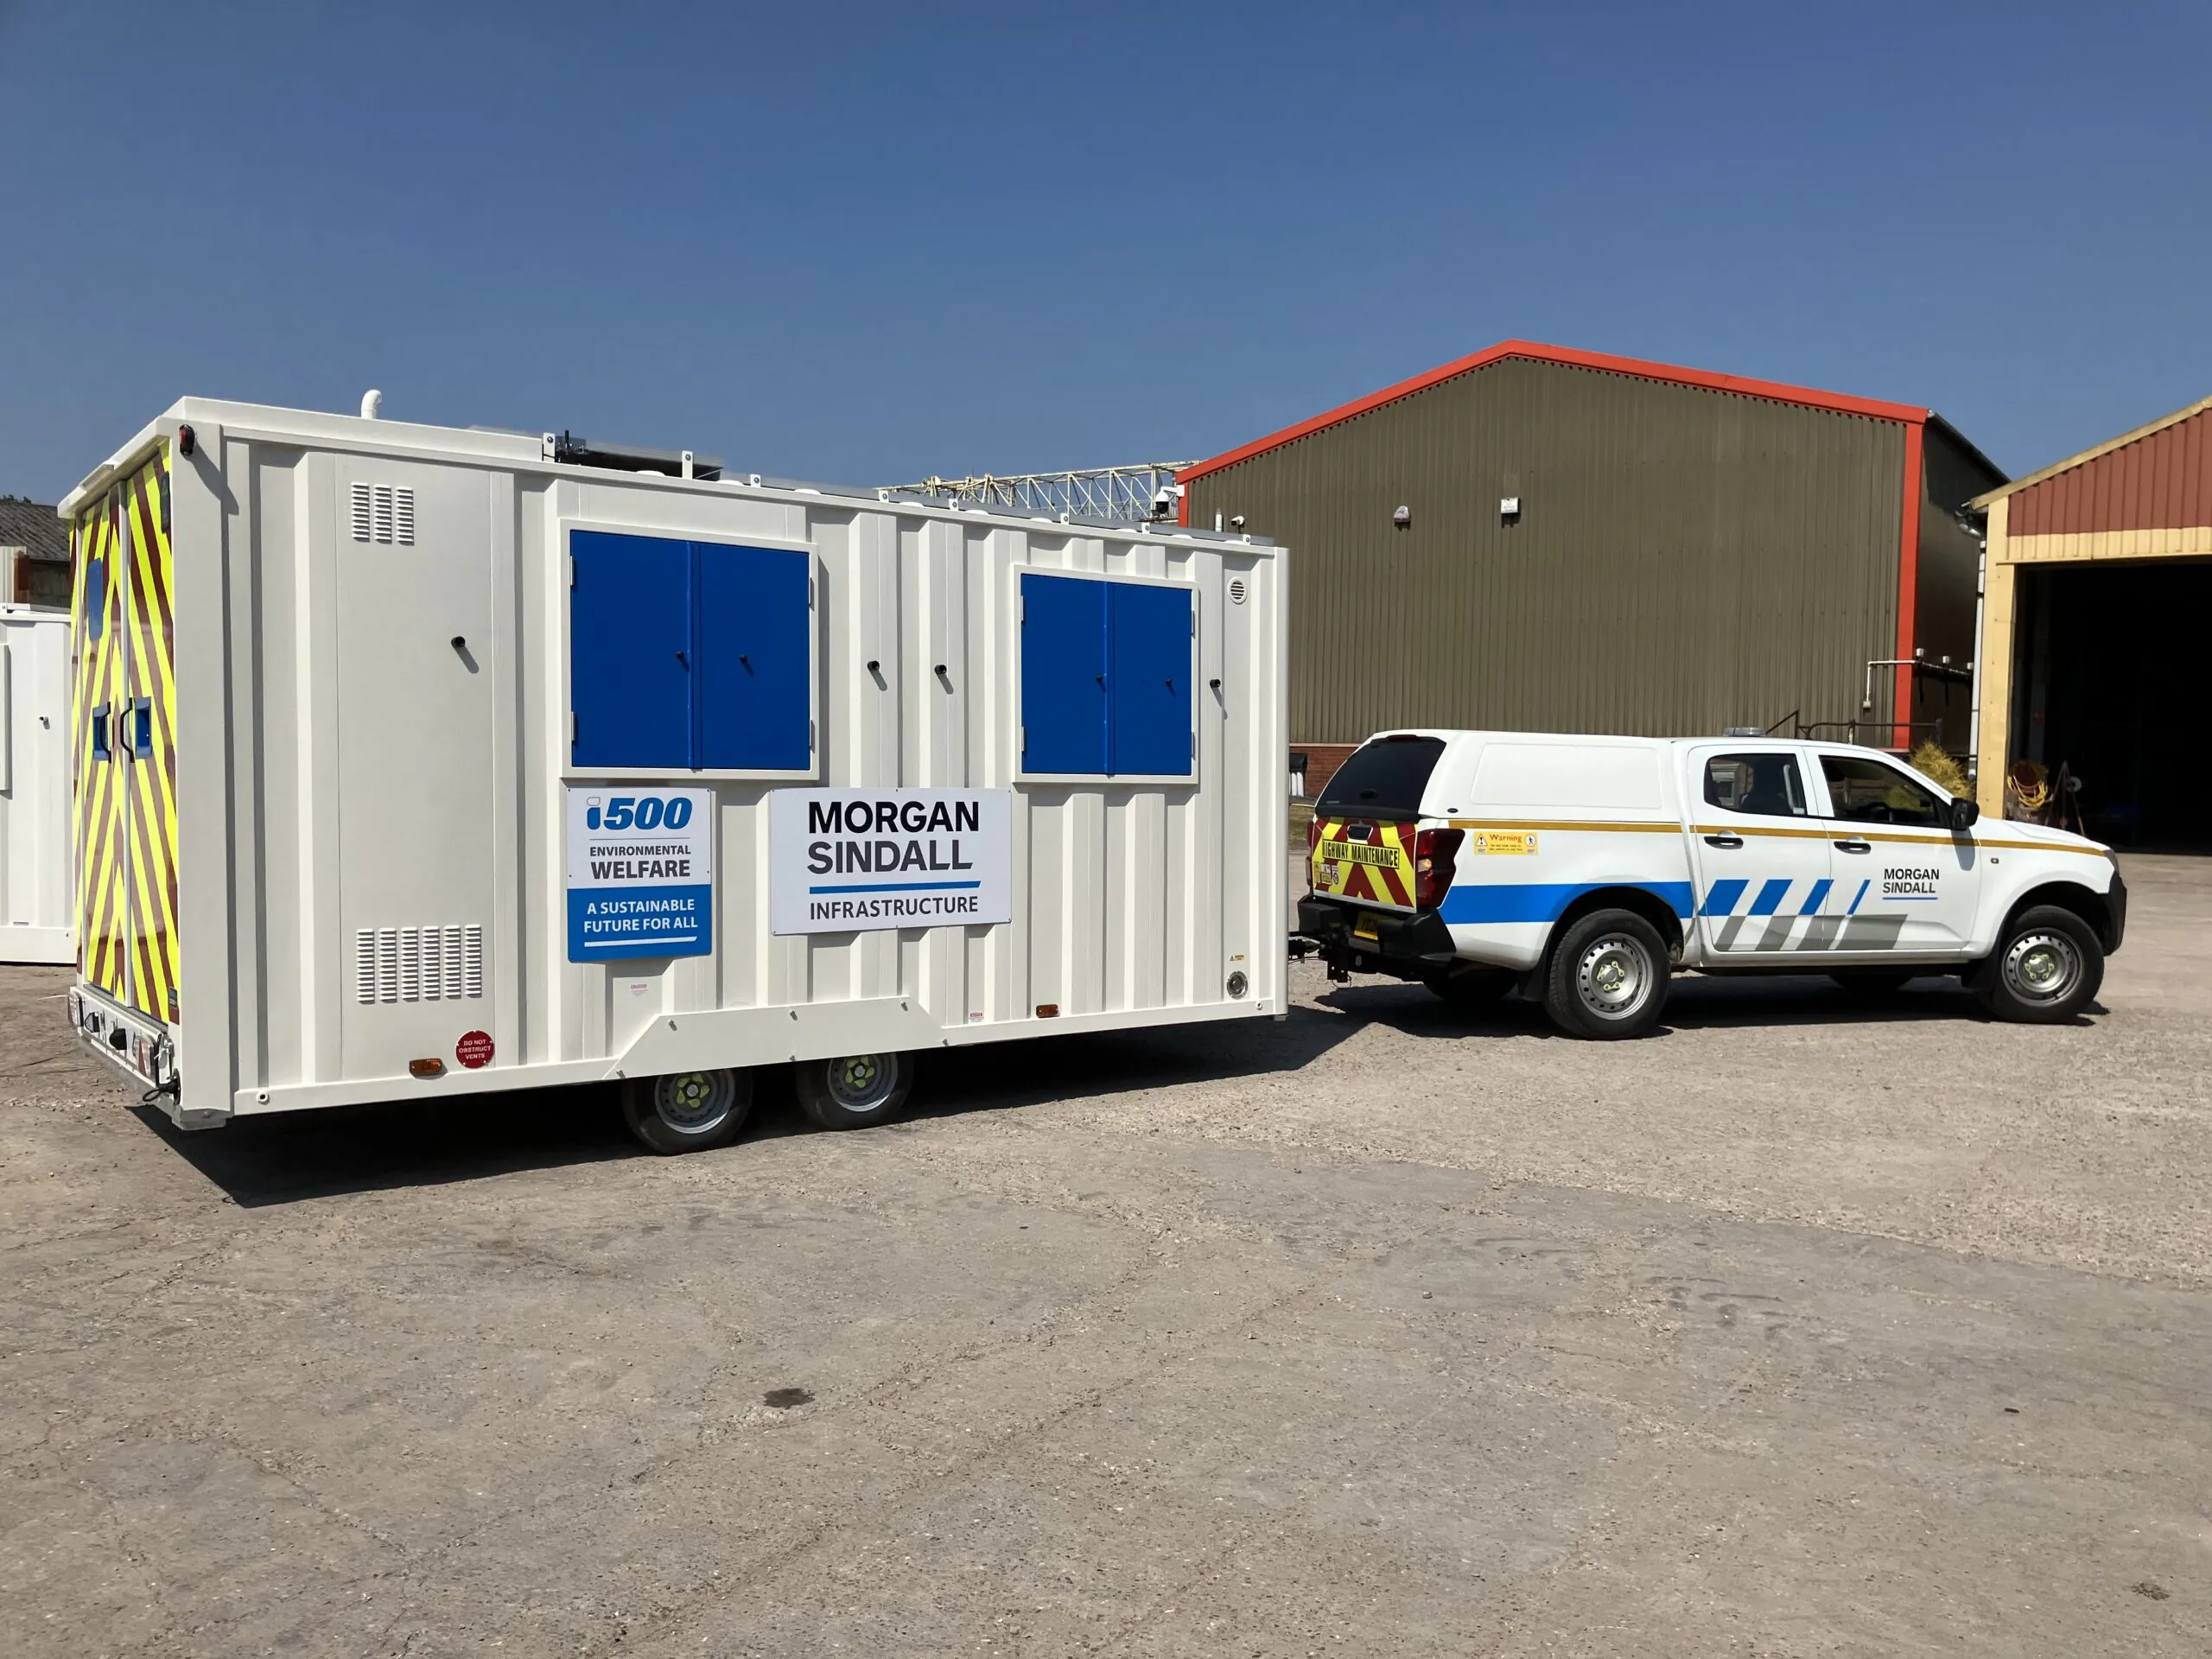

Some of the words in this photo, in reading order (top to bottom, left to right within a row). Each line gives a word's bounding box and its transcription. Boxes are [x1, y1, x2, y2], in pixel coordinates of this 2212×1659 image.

[587, 797, 693, 830] i500
[809, 801, 979, 834] MORGAN
[1489, 833, 1522, 843] Warning
[590, 845, 691, 856] ENVIRONMENTAL
[807, 840, 974, 874] SINDALL
[1351, 845, 1398, 867] MAINTENANCE
[591, 860, 691, 880] WELFARE
[1884, 868, 1940, 880] MORGAN
[1883, 881, 1936, 893] SINDALL
[587, 903, 597, 915] A
[601, 899, 696, 914] SUSTAINABLE
[810, 896, 978, 920] INFRASTRUCTURE
[584, 918, 640, 933] FUTURE
[643, 918, 671, 930] FOR
[673, 917, 698, 929] ALL
